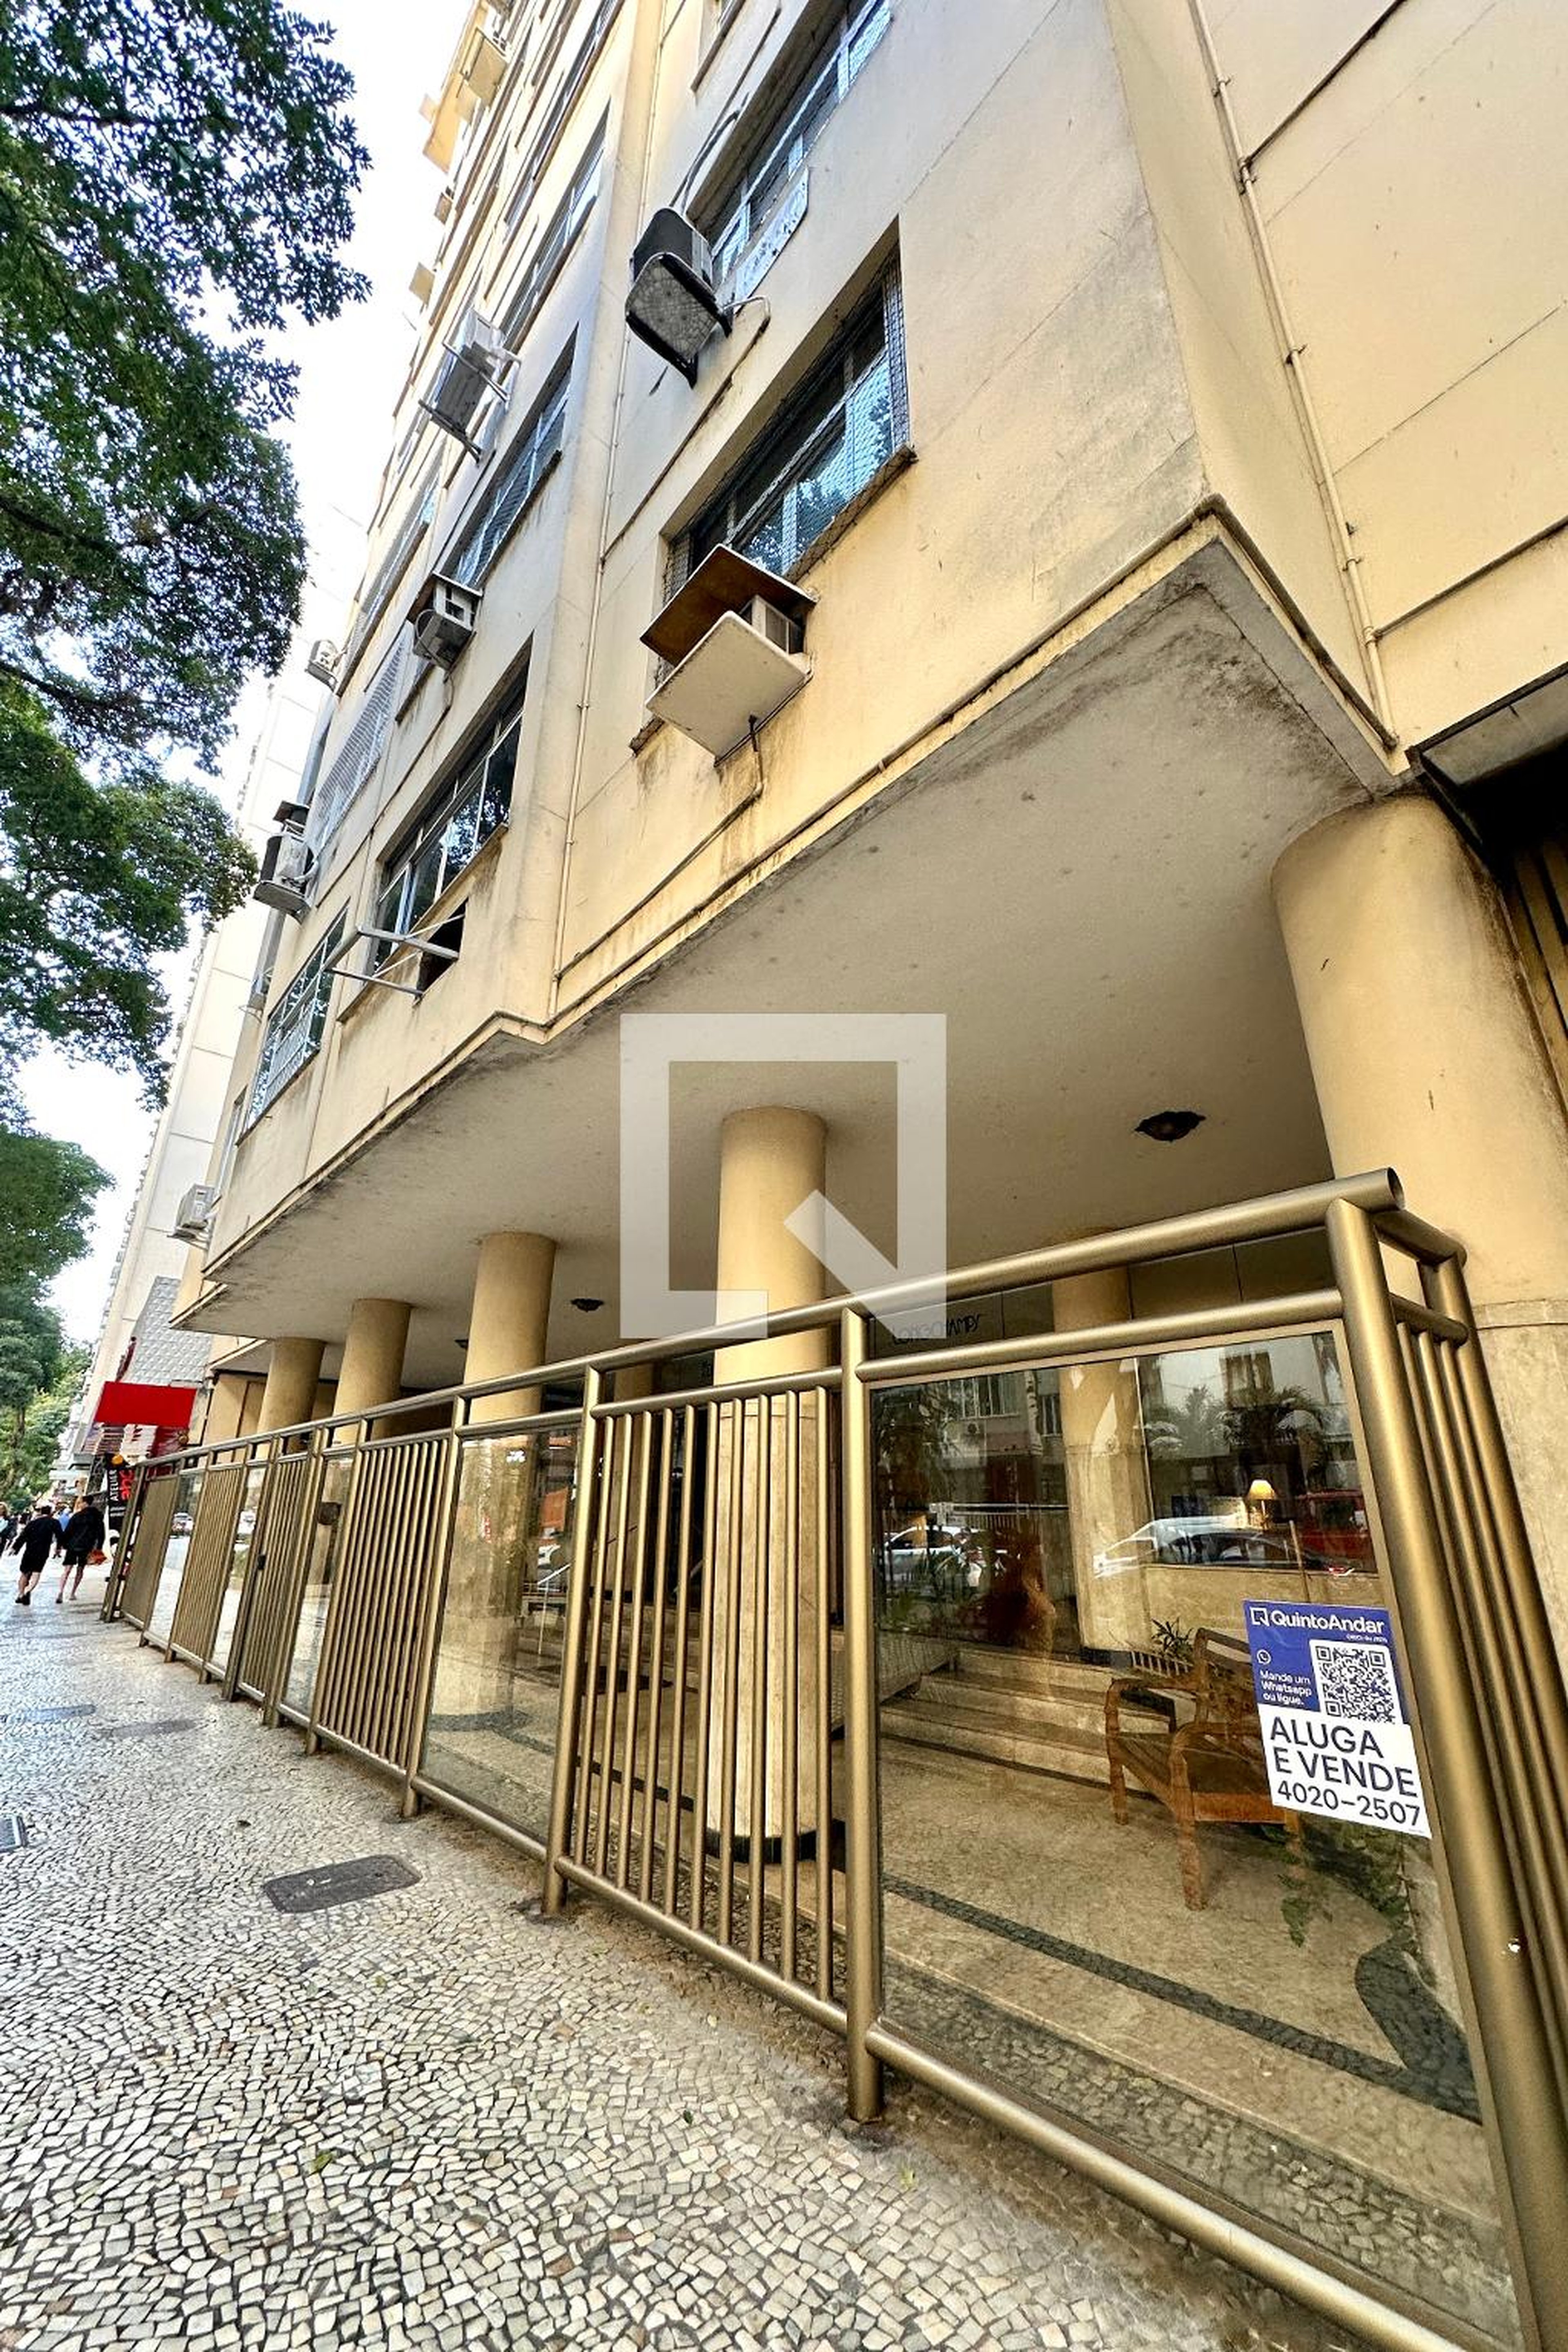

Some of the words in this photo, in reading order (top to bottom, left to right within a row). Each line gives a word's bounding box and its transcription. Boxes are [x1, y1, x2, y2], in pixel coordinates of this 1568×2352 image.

[1271, 1610, 1384, 1634] QuintoAndar
[1260, 1670, 1293, 1683] Mande
[1295, 1676, 1311, 1684] um
[1263, 1693, 1276, 1702] ou
[1270, 1717, 1384, 1758] ALUGA
[1274, 1746, 1292, 1774] E
[1296, 1751, 1418, 1798] VENDE
[1278, 1780, 1420, 1826] 4020-2507
